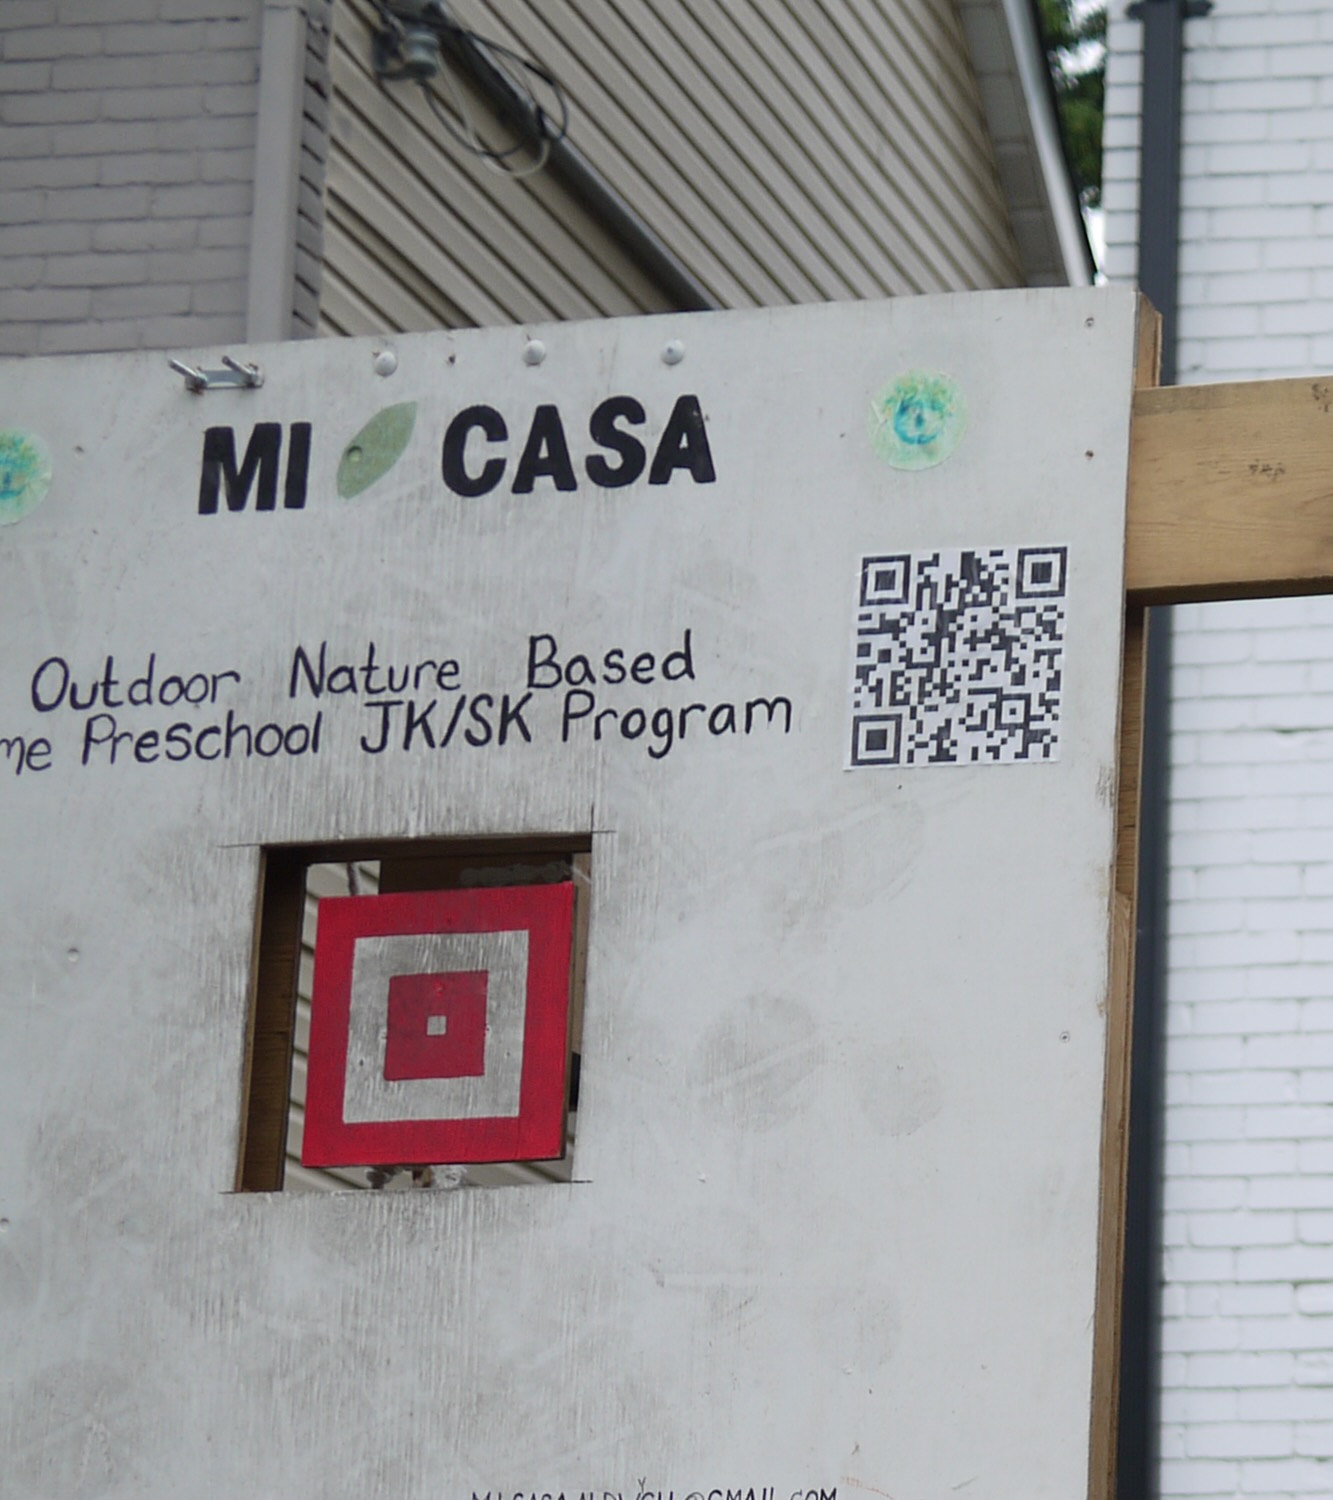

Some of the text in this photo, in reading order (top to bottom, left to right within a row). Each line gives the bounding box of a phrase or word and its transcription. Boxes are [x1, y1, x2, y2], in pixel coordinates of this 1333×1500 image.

[198, 394, 717, 515] MI CASA
[31, 628, 696, 713] Outdoor Nature Based
[81, 709, 323, 766] Preschool
[360, 691, 533, 755] JK/SK
[561, 688, 793, 760] Program
